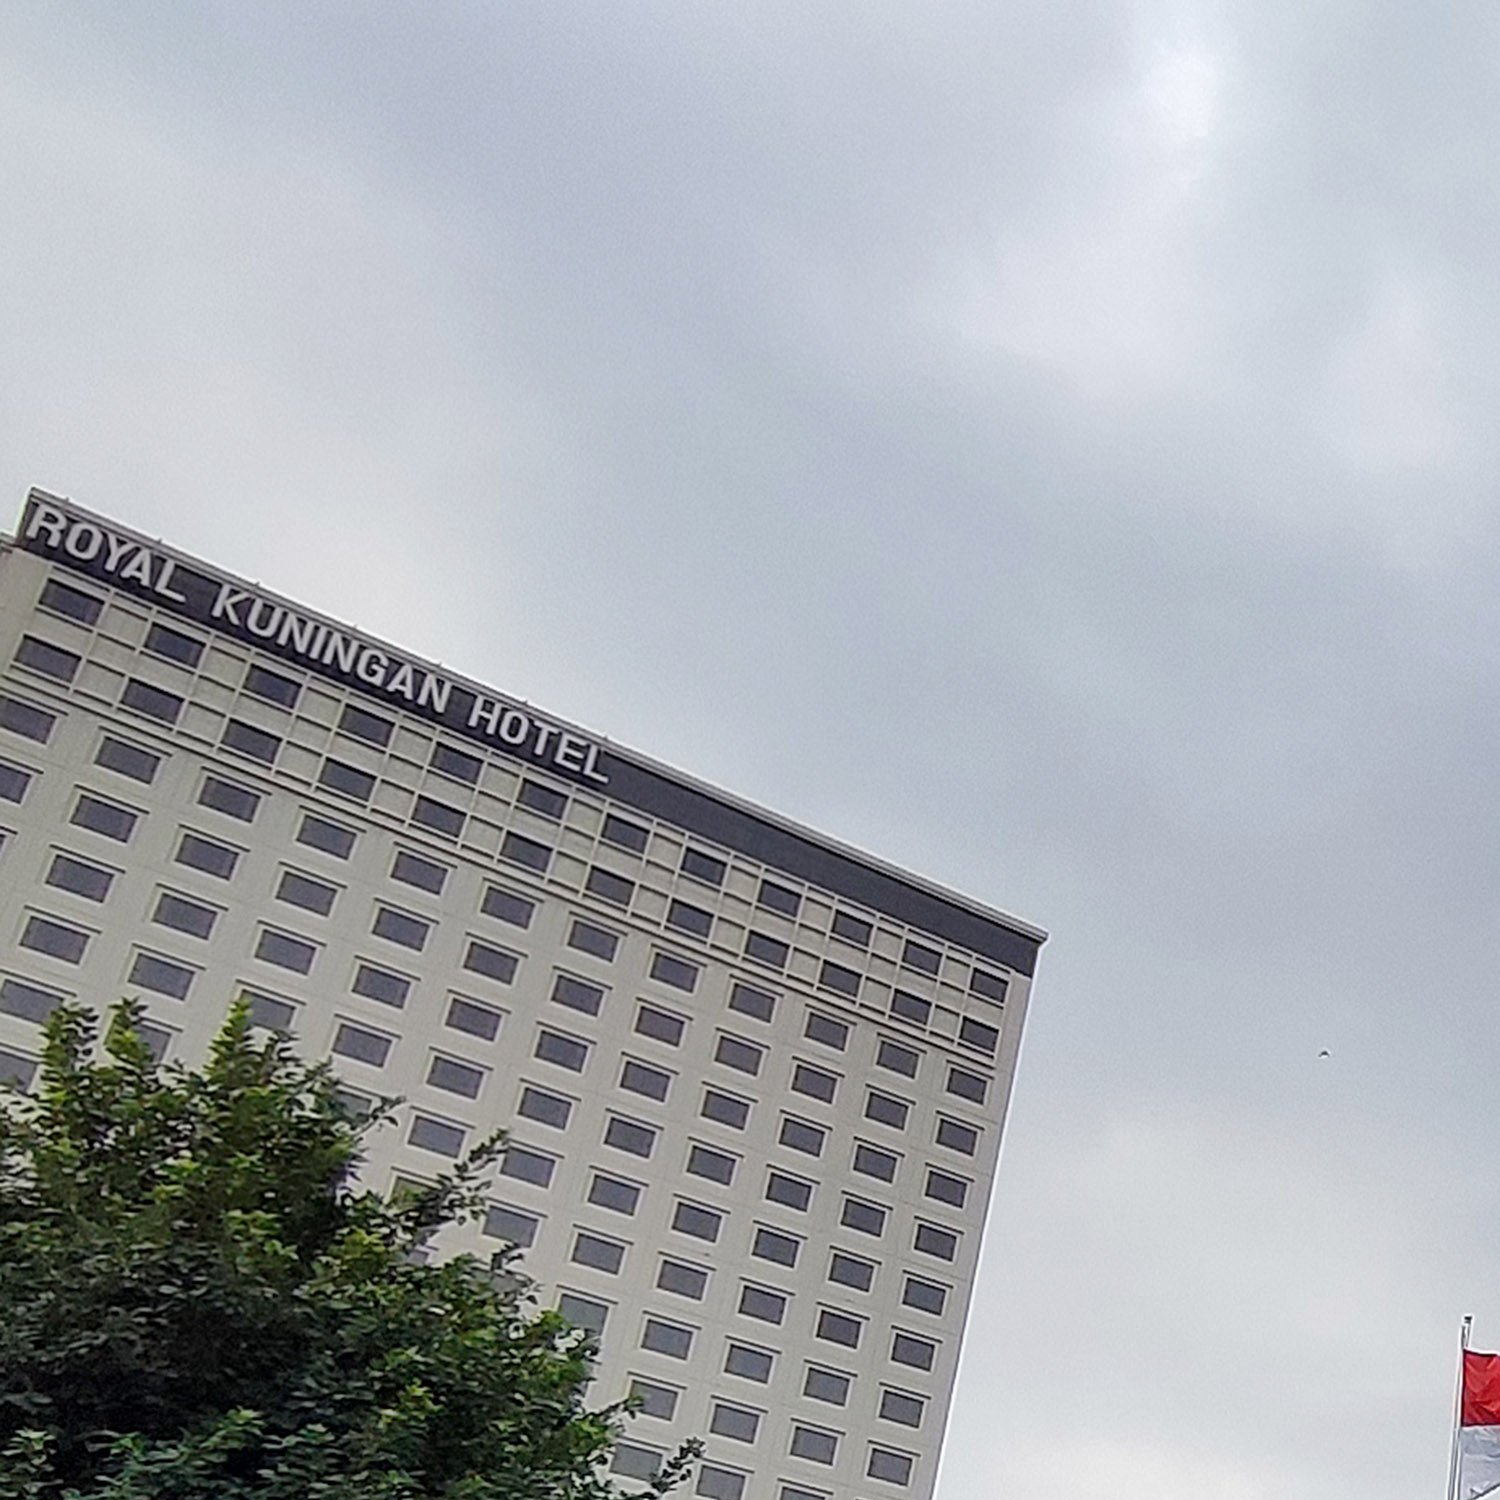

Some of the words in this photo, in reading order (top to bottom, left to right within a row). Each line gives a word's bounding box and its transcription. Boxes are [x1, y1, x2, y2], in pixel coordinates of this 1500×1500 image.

[26, 503, 186, 602] ROYAL
[210, 583, 452, 714] KUNINGAN
[466, 695, 609, 784] HOTEL
